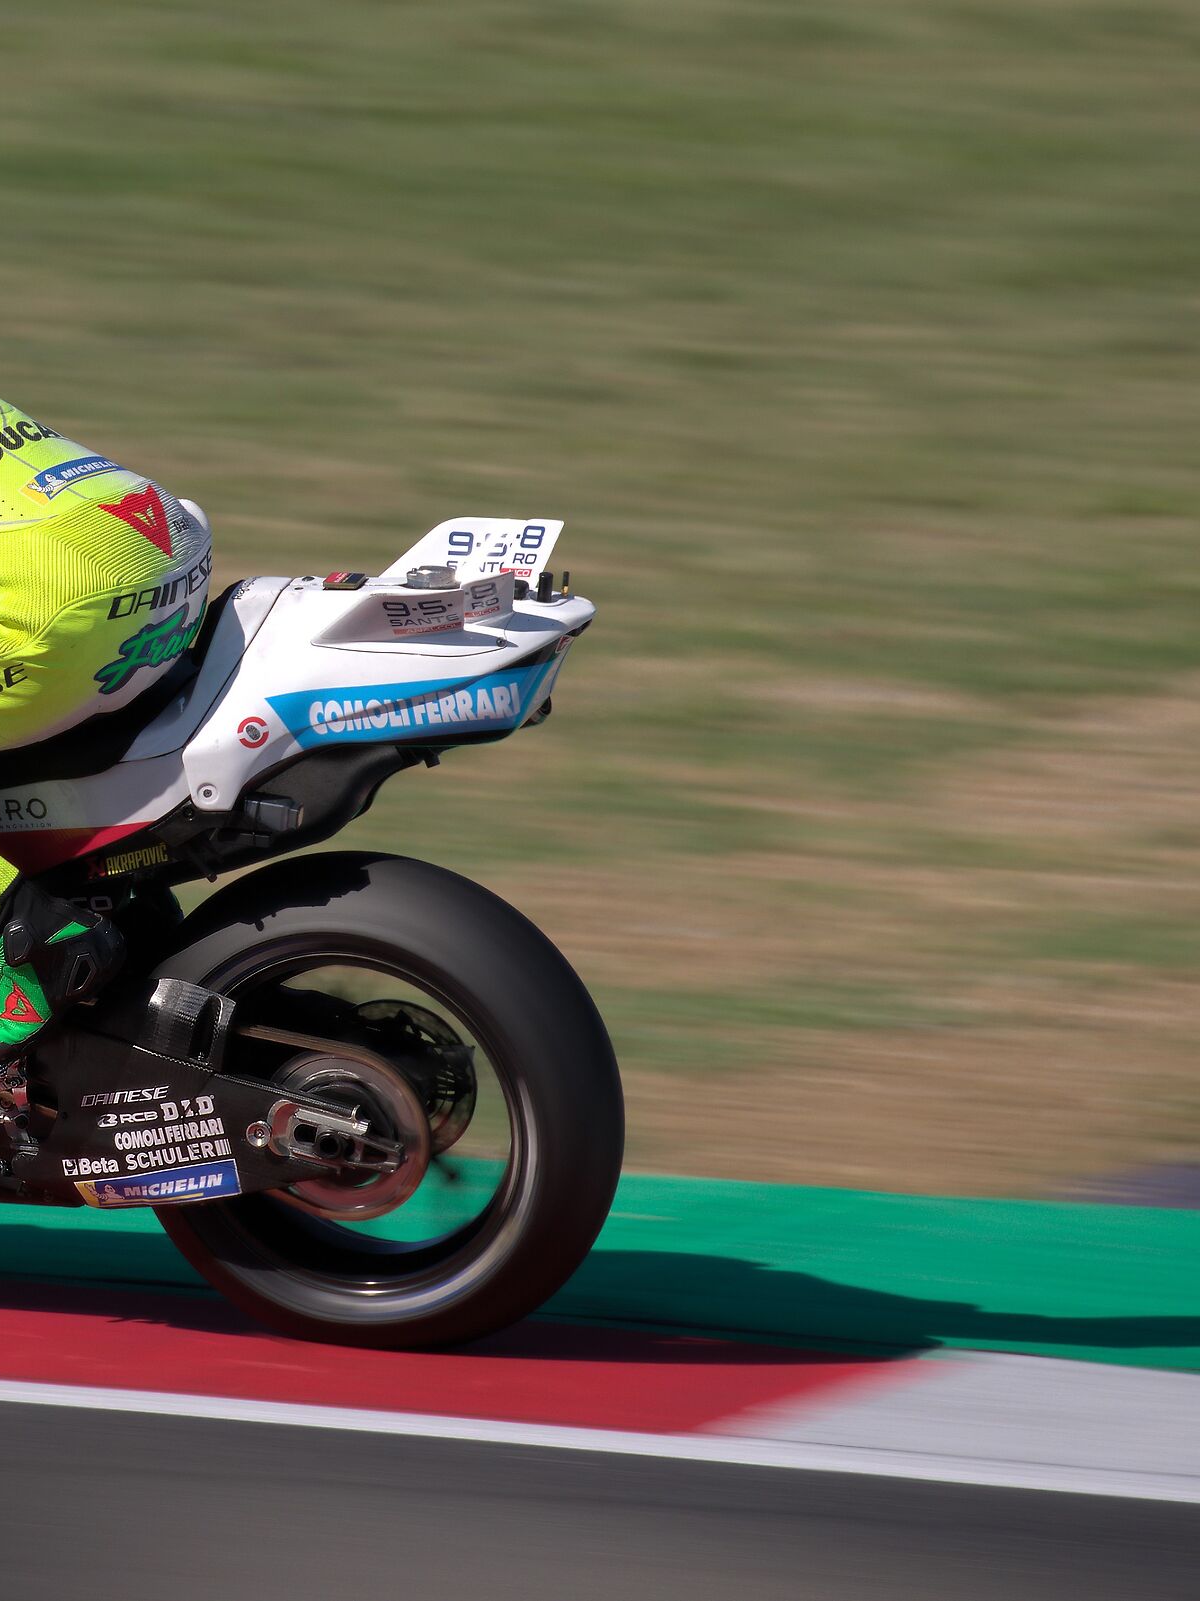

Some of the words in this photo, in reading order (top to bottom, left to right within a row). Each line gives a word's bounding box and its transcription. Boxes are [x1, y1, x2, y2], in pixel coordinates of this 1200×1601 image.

[107, 546, 213, 620] DAINESE
[309, 699, 410, 735] COMOLI
[408, 683, 521, 726] FERRARI
[81, 1086, 170, 1108] DAINESE
[114, 1124, 166, 1151] COMOLI
[166, 1117, 225, 1144] FERRARI
[119, 1111, 158, 1124] RCB
[78, 1157, 119, 1176] Beta
[125, 1139, 215, 1171] SCHULER
[124, 1174, 223, 1197] MICHELIN
